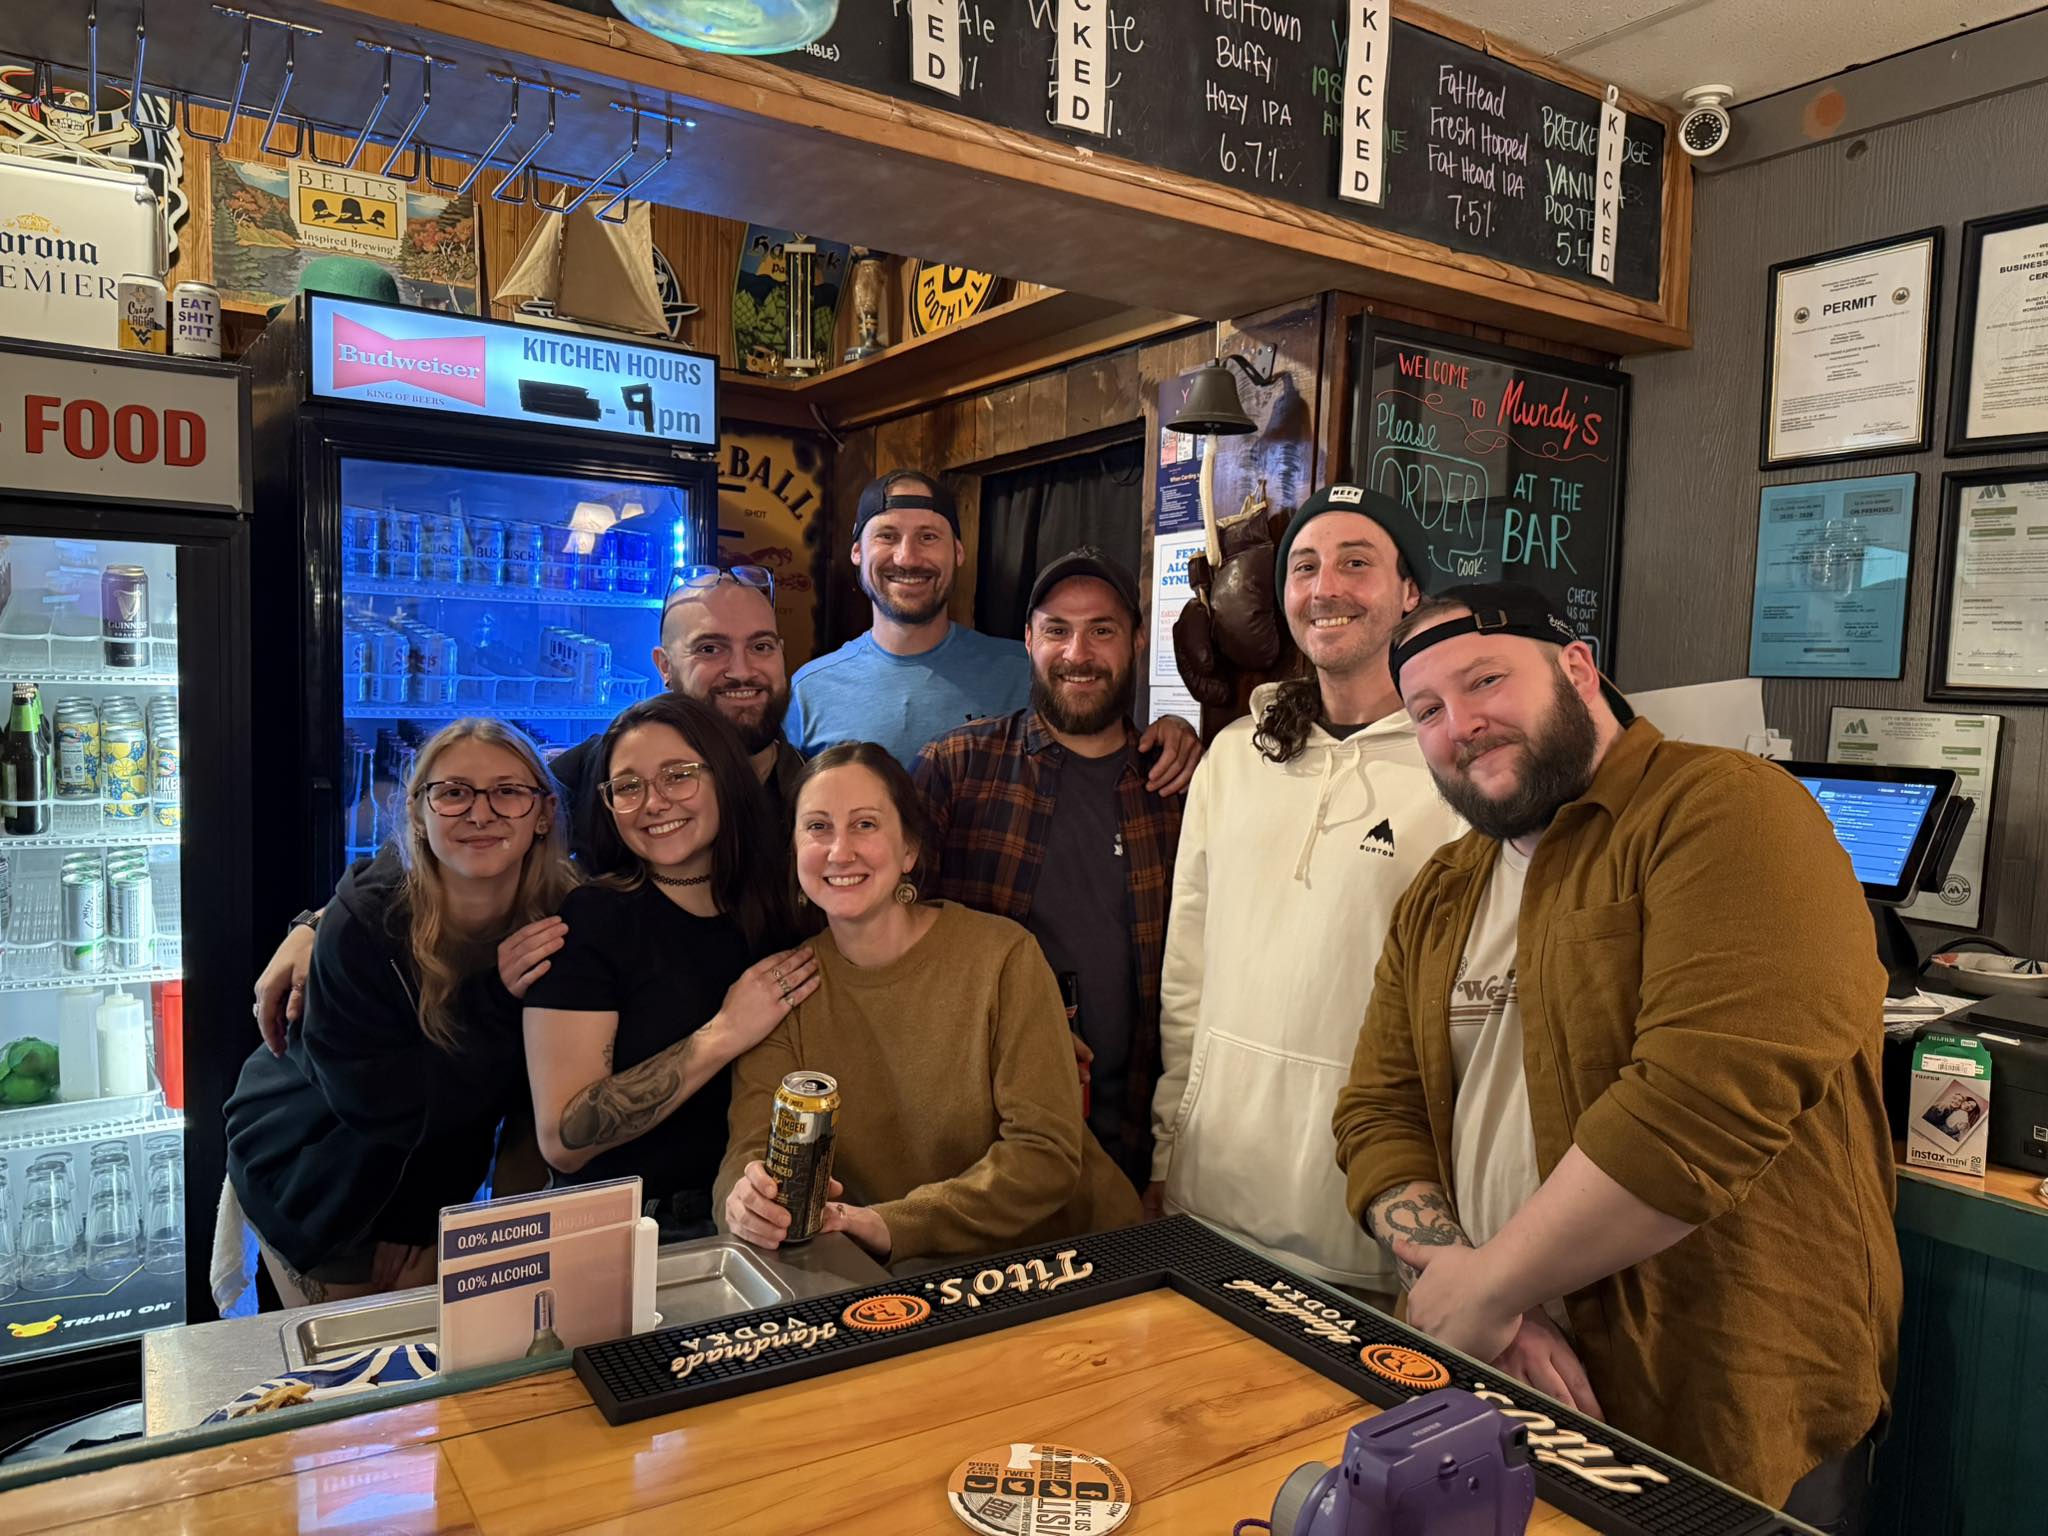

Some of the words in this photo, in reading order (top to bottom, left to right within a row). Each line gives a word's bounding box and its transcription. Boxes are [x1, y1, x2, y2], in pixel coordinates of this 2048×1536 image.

[1029, 0, 1144, 53] Wte
[1216, 36, 1272, 84] Buffy
[1206, 79, 1248, 125] Hazy
[1262, 99, 1292, 126] IPA
[1354, 7, 1378, 192] KICKED
[1430, 107, 1476, 150] Fresh
[1481, 122, 1529, 167] Hopped
[298, 169, 398, 202] BELL'S
[1428, 144, 1458, 178] Fat
[1461, 157, 1497, 192] Head
[1502, 171, 1526, 200] IPA
[1600, 112, 1619, 273] KICKED
[1545, 195, 1597, 232] PORTE
[303, 230, 347, 246] Inspired
[350, 239, 394, 256] Brewing
[2023, 251, 2044, 260] STATE
[2000, 259, 2048, 273] BUSINESS
[128, 301, 154, 319] Crisp
[179, 311, 214, 325] SHIT
[181, 298, 211, 311] EAT
[1823, 294, 1877, 316] PERMIT
[180, 325, 213, 338] PITT
[337, 343, 480, 381] Budweiser
[523, 336, 619, 374] KITCHEN
[628, 354, 701, 385] HOURS
[366, 388, 392, 400] KING
[395, 393, 409, 401] OF
[411, 395, 445, 405] BEERS
[1399, 352, 1469, 389] WELCOME
[1471, 397, 1487, 418] TO
[1498, 378, 1602, 450] Mundy's
[25, 394, 206, 467] FOOD
[1377, 402, 1440, 451] Please
[1379, 456, 1478, 538] ORDER
[1513, 473, 1538, 503] AT
[1550, 477, 1584, 512] THE
[744, 508, 767, 519] SHOT
[1502, 508, 1578, 575] BAR
[1567, 586, 1598, 607] CHECK
[107, 620, 148, 630] GUINNESS
[1567, 606, 1578, 619] US
[1580, 608, 1596, 620] OUT
[1577, 621, 1589, 633] ON
[1359, 844, 1394, 858] BURTON
[1911, 1146, 1945, 1162] instax
[1946, 1156, 1967, 1167] mini
[1970, 1155, 1981, 1164] 20
[457, 1232, 488, 1250] 0.0%
[490, 1220, 544, 1245] ALCOHOL
[457, 1274, 488, 1293] 0.0%
[490, 1262, 544, 1287] ALCOHOL
[63, 1309, 133, 1330] TRAIN
[138, 1302, 173, 1316] ON
[1271, 1280, 1356, 1331] VODKA
[680, 1317, 807, 1350] VODKA
[671, 1321, 838, 1380] Handmade
[1004, 1469, 1035, 1478] TWEET
[1075, 1500, 1091, 1517] LIKE
[1075, 1519, 1091, 1532] US
